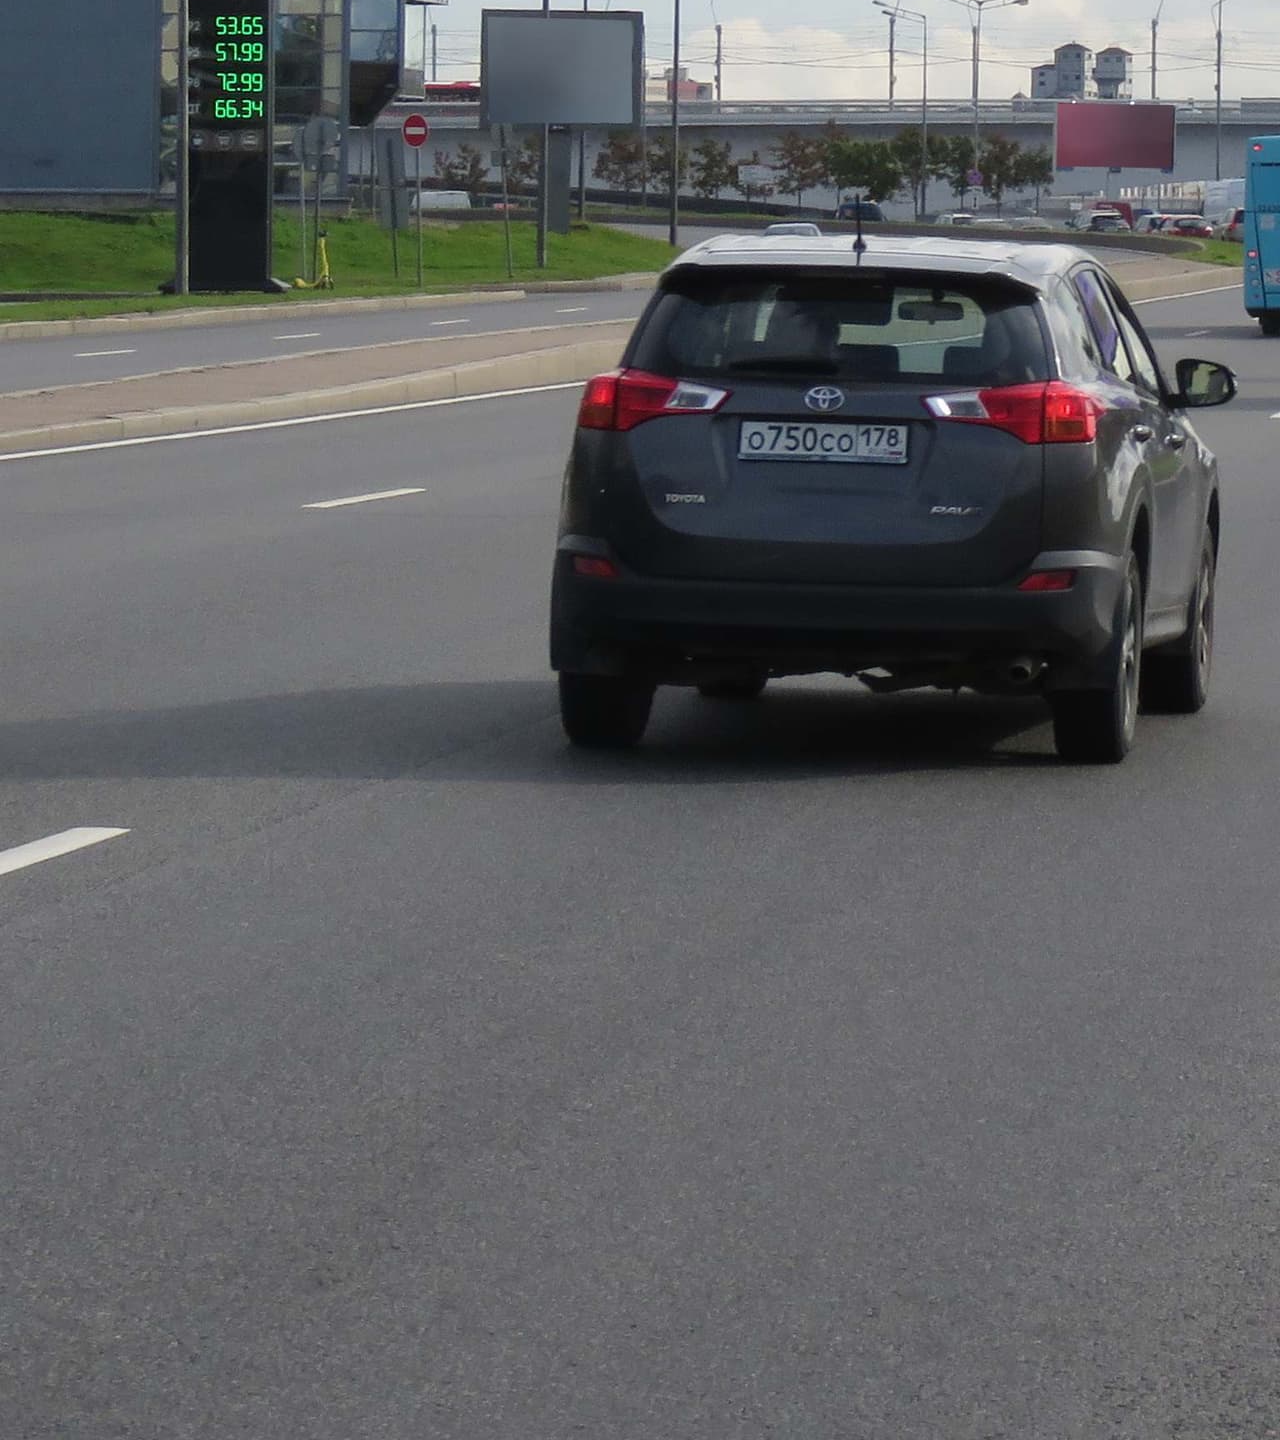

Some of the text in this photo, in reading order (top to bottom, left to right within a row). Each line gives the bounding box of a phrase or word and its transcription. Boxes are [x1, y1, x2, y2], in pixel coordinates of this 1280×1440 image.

[215, 16, 264, 35] 53.65
[215, 43, 263, 62] 57.99
[216, 73, 263, 92] 72.99
[215, 99, 263, 118] 66.34
[860, 427, 899, 448] 178
[665, 493, 706, 503] TOYOTA
